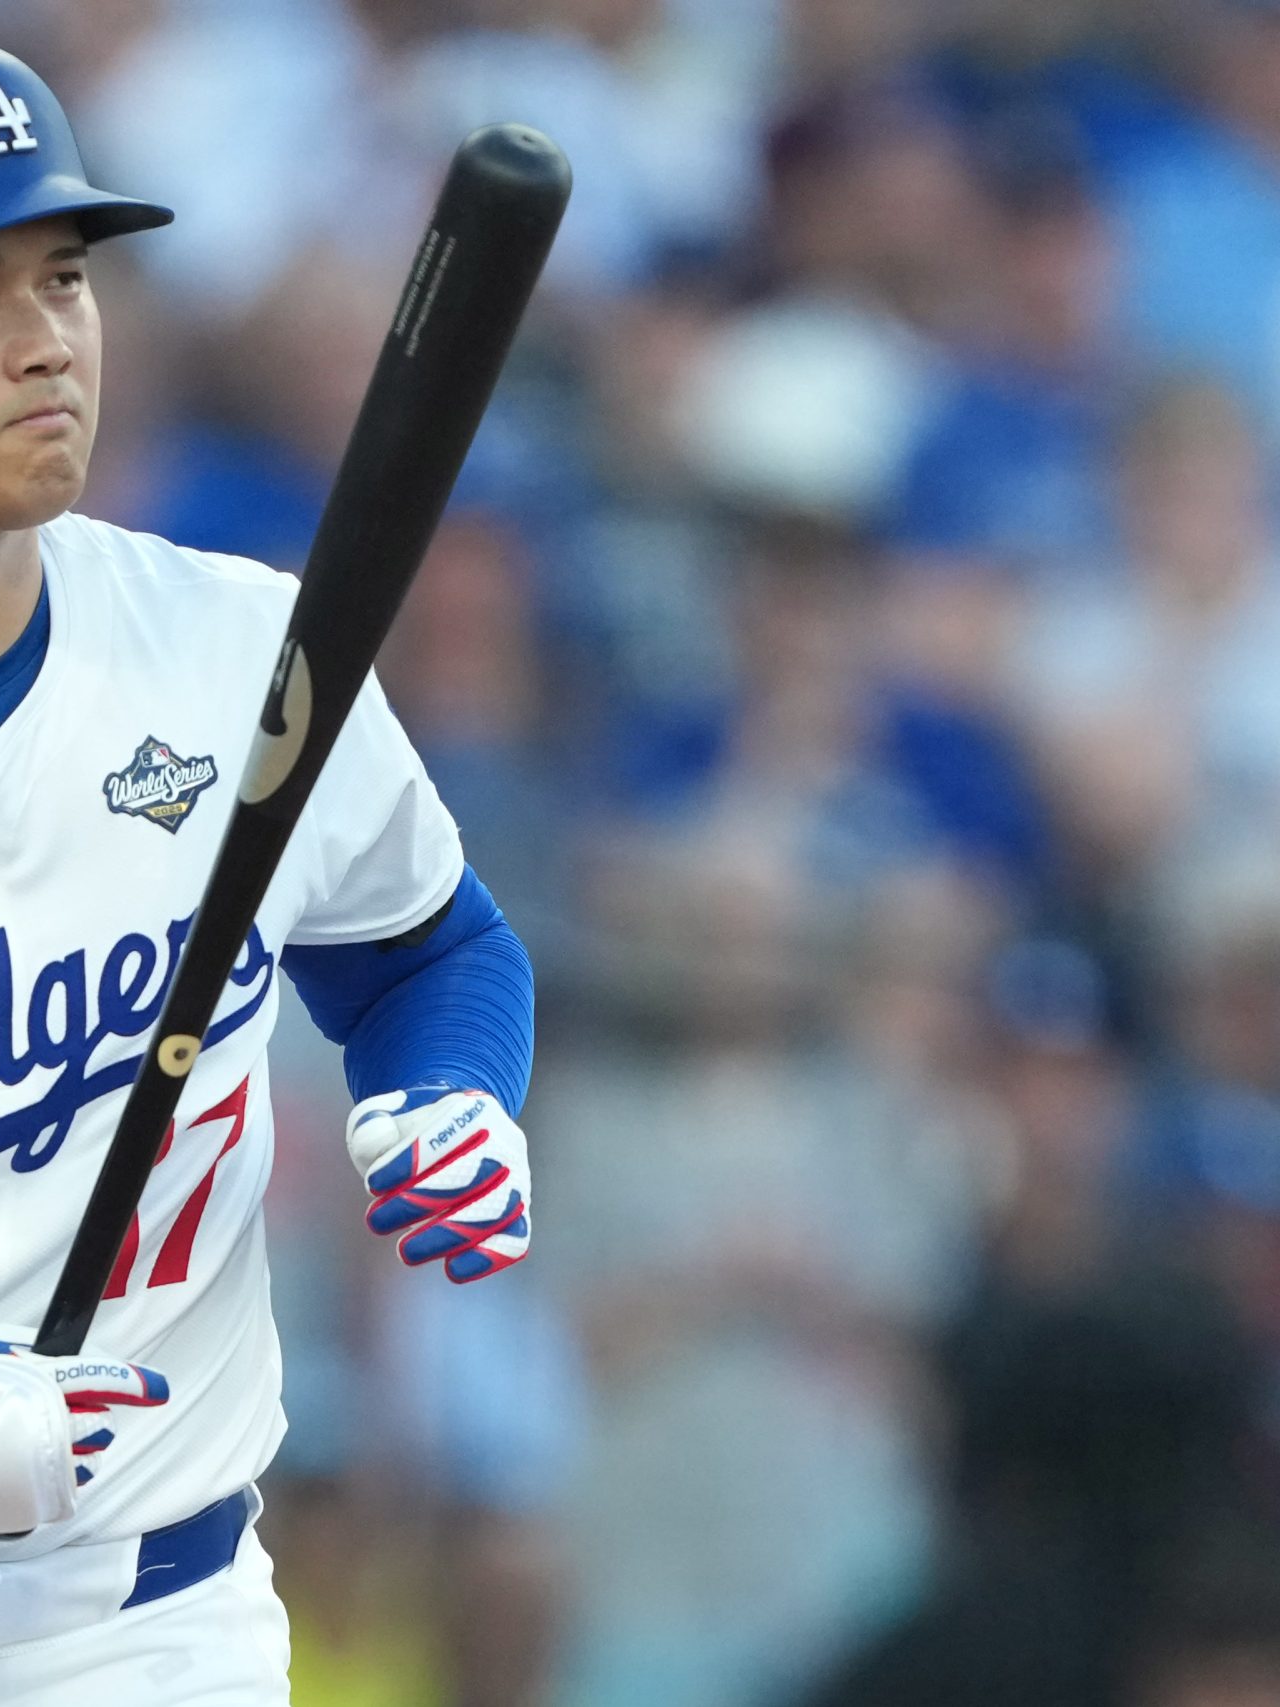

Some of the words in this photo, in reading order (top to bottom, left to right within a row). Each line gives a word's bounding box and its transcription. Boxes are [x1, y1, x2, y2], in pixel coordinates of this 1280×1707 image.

[107, 768, 167, 808] World
[161, 759, 215, 803] Series
[428, 1122, 457, 1151] new
